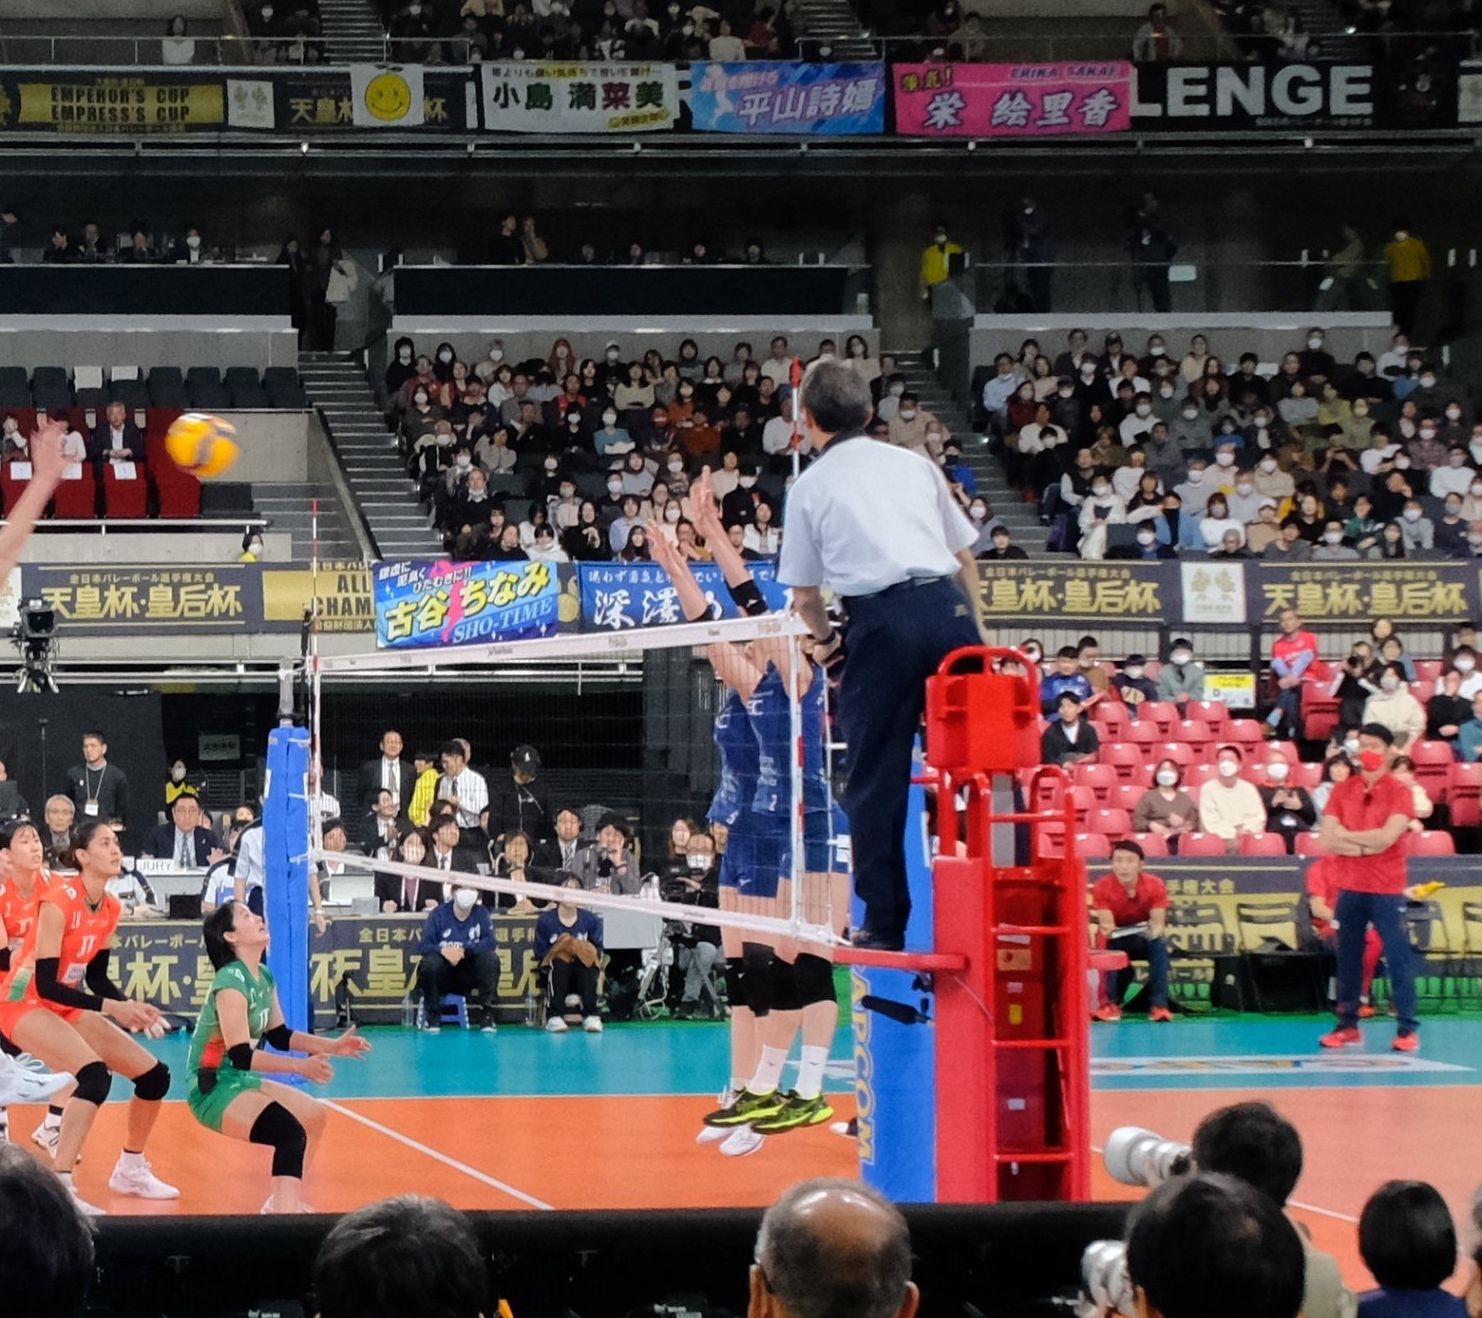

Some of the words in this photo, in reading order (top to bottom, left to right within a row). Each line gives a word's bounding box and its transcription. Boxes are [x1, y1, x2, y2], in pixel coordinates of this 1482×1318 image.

[51, 88, 145, 104] EMPEROR'S
[156, 87, 190, 103] CUP
[493, 82, 553, 110] 小島
[568, 82, 665, 110] 満菜美
[51, 105, 146, 121] EMPRESS'S
[156, 105, 190, 121] CUP
[924, 90, 966, 129] 栄
[990, 88, 1121, 130] 絵里香
[70, 574, 215, 585] 全日本バレーボール選手権大会
[337, 575, 372, 594] ALL
[385, 561, 551, 640] 古谷ちなみ
[452, 597, 553, 645] SHO-TIME
[139, 860, 172, 871] JURY
